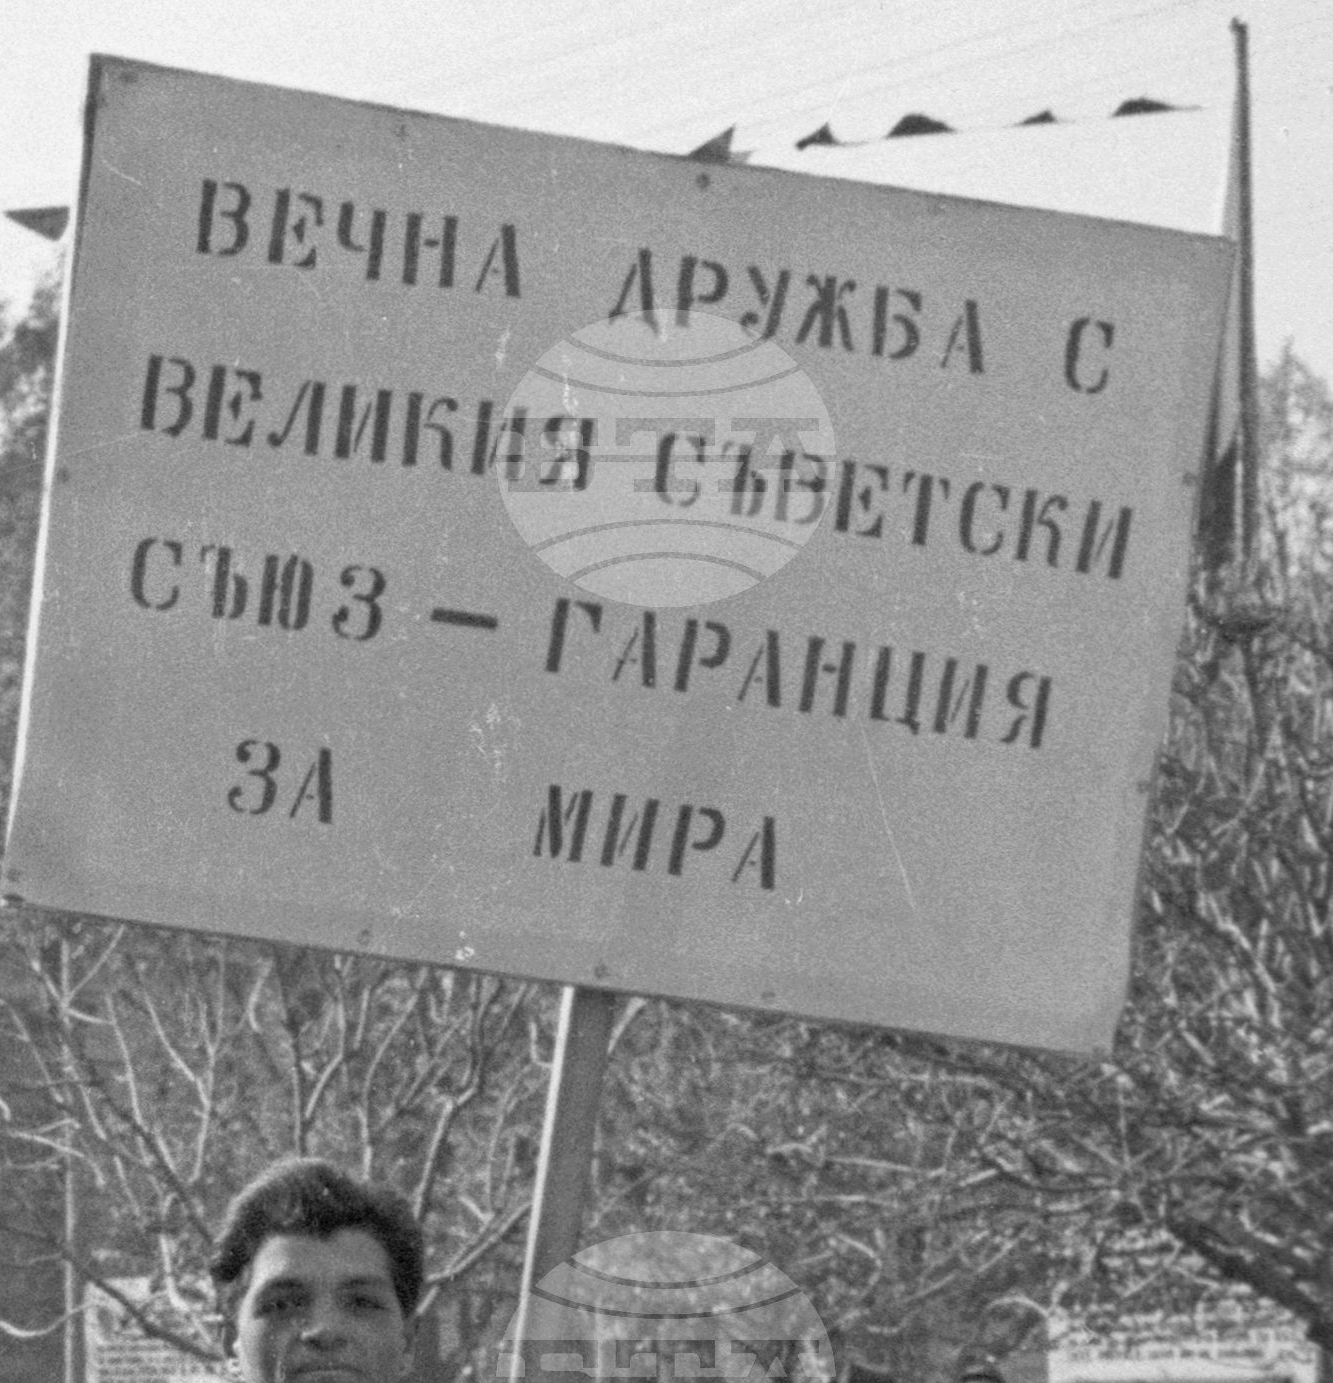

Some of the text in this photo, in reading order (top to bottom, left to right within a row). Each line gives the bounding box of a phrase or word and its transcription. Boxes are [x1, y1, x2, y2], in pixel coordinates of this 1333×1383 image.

[195, 178, 1116, 395] ВЕЧНА ДРУЖБА С
[139, 354, 1134, 581] ВЕЛИКИЯ СЪВЕТСКИ
[129, 536, 388, 642] СЪЮЗ
[543, 596, 1053, 751] ГАРАНЦИЯ
[227, 739, 778, 892] ЗА МИРА
